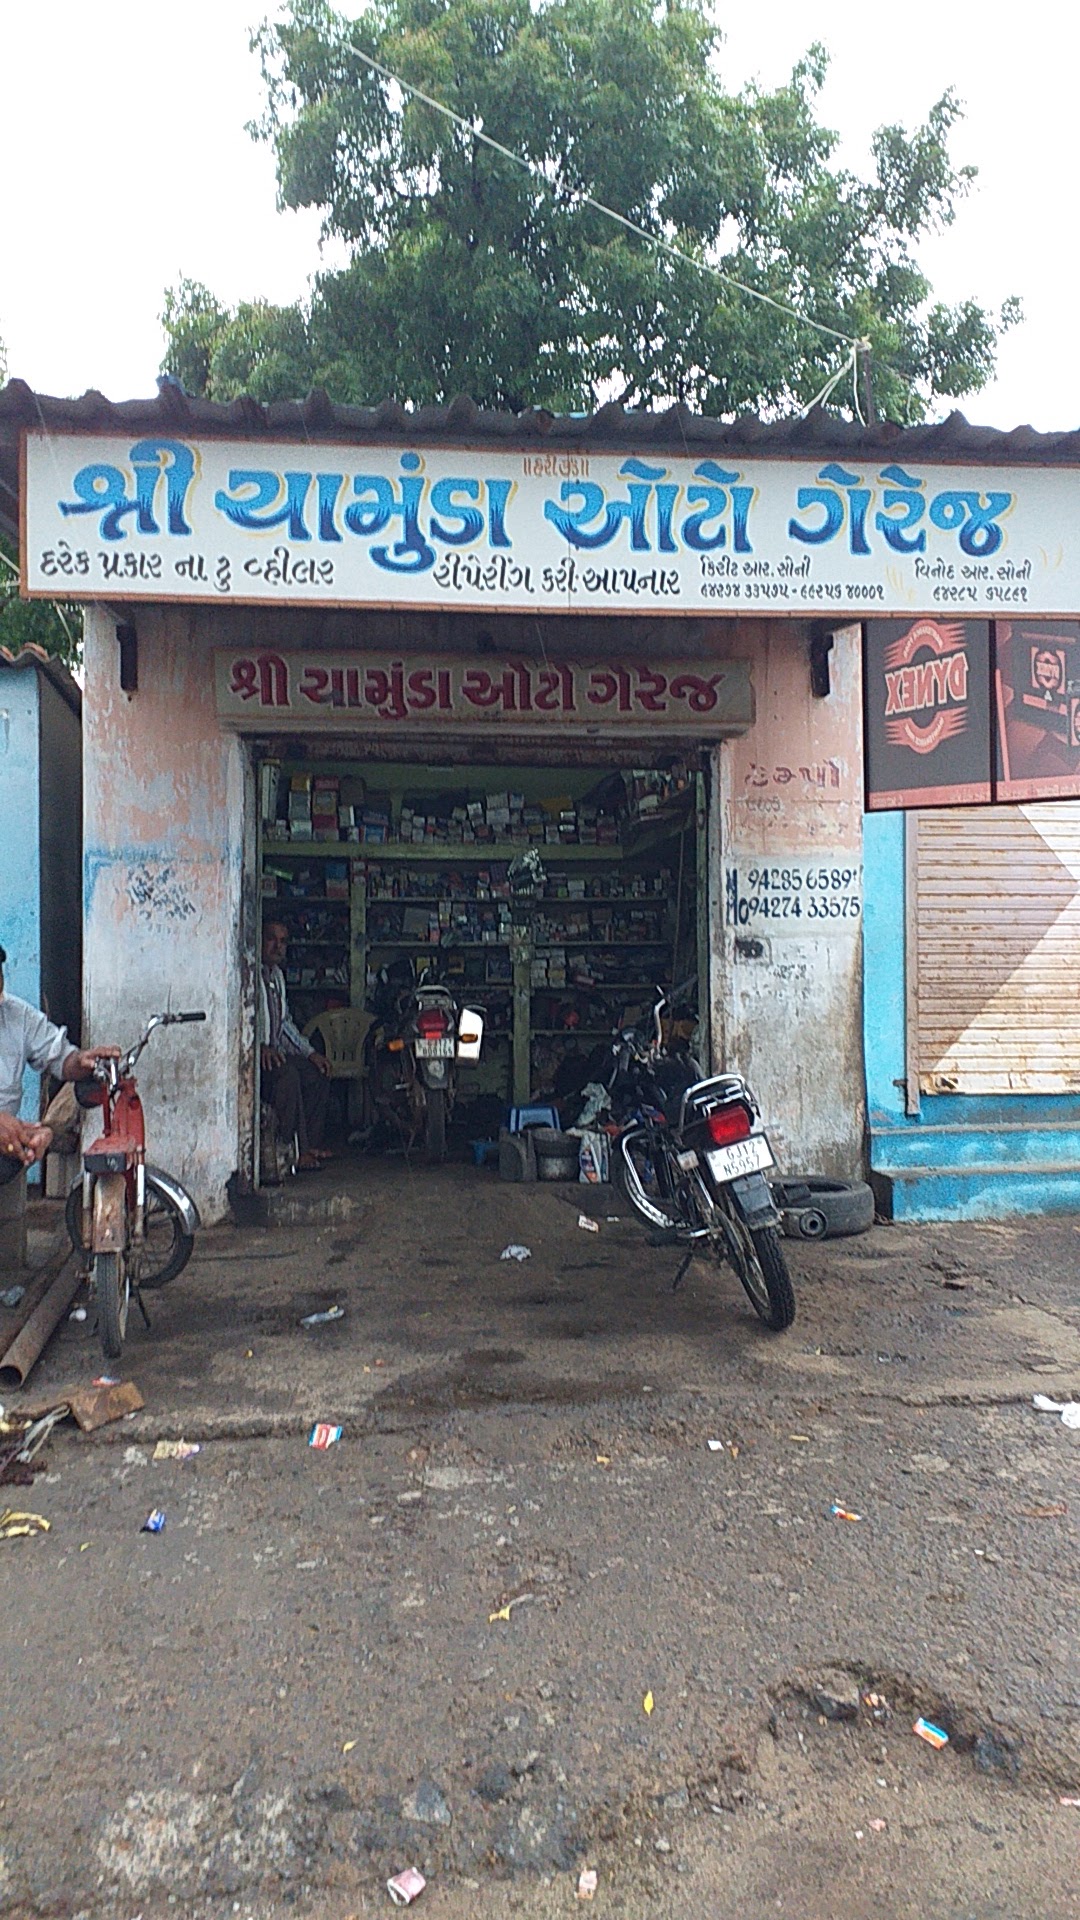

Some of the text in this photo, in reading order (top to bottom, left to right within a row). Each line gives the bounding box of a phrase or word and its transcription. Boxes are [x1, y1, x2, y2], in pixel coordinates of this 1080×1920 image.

[58, 438, 1014, 573] શ્રી ચામુંડા ઓટો ગેરેજ
[40, 541, 90, 576] દરેક
[98, 551, 162, 579] પ્રકાર
[175, 553, 208, 582] ના
[213, 555, 231, 592] ટુ
[433, 552, 535, 593] રીપેરીંગ
[541, 557, 578, 592] કરી
[582, 567, 681, 595] આપનાર
[700, 555, 738, 577] કિરીટ
[777, 555, 811, 578] સોની
[915, 557, 955, 580] વિનોદ
[997, 559, 1032, 581] સોની
[229, 653, 726, 721] શ્રી ચામુંડા ઓટો ગેરેજ
[748, 868, 802, 892] 94285
[748, 896, 802, 918] 94274
[807, 896, 860, 918] 33575
[726, 1140, 757, 1161] GJ12
